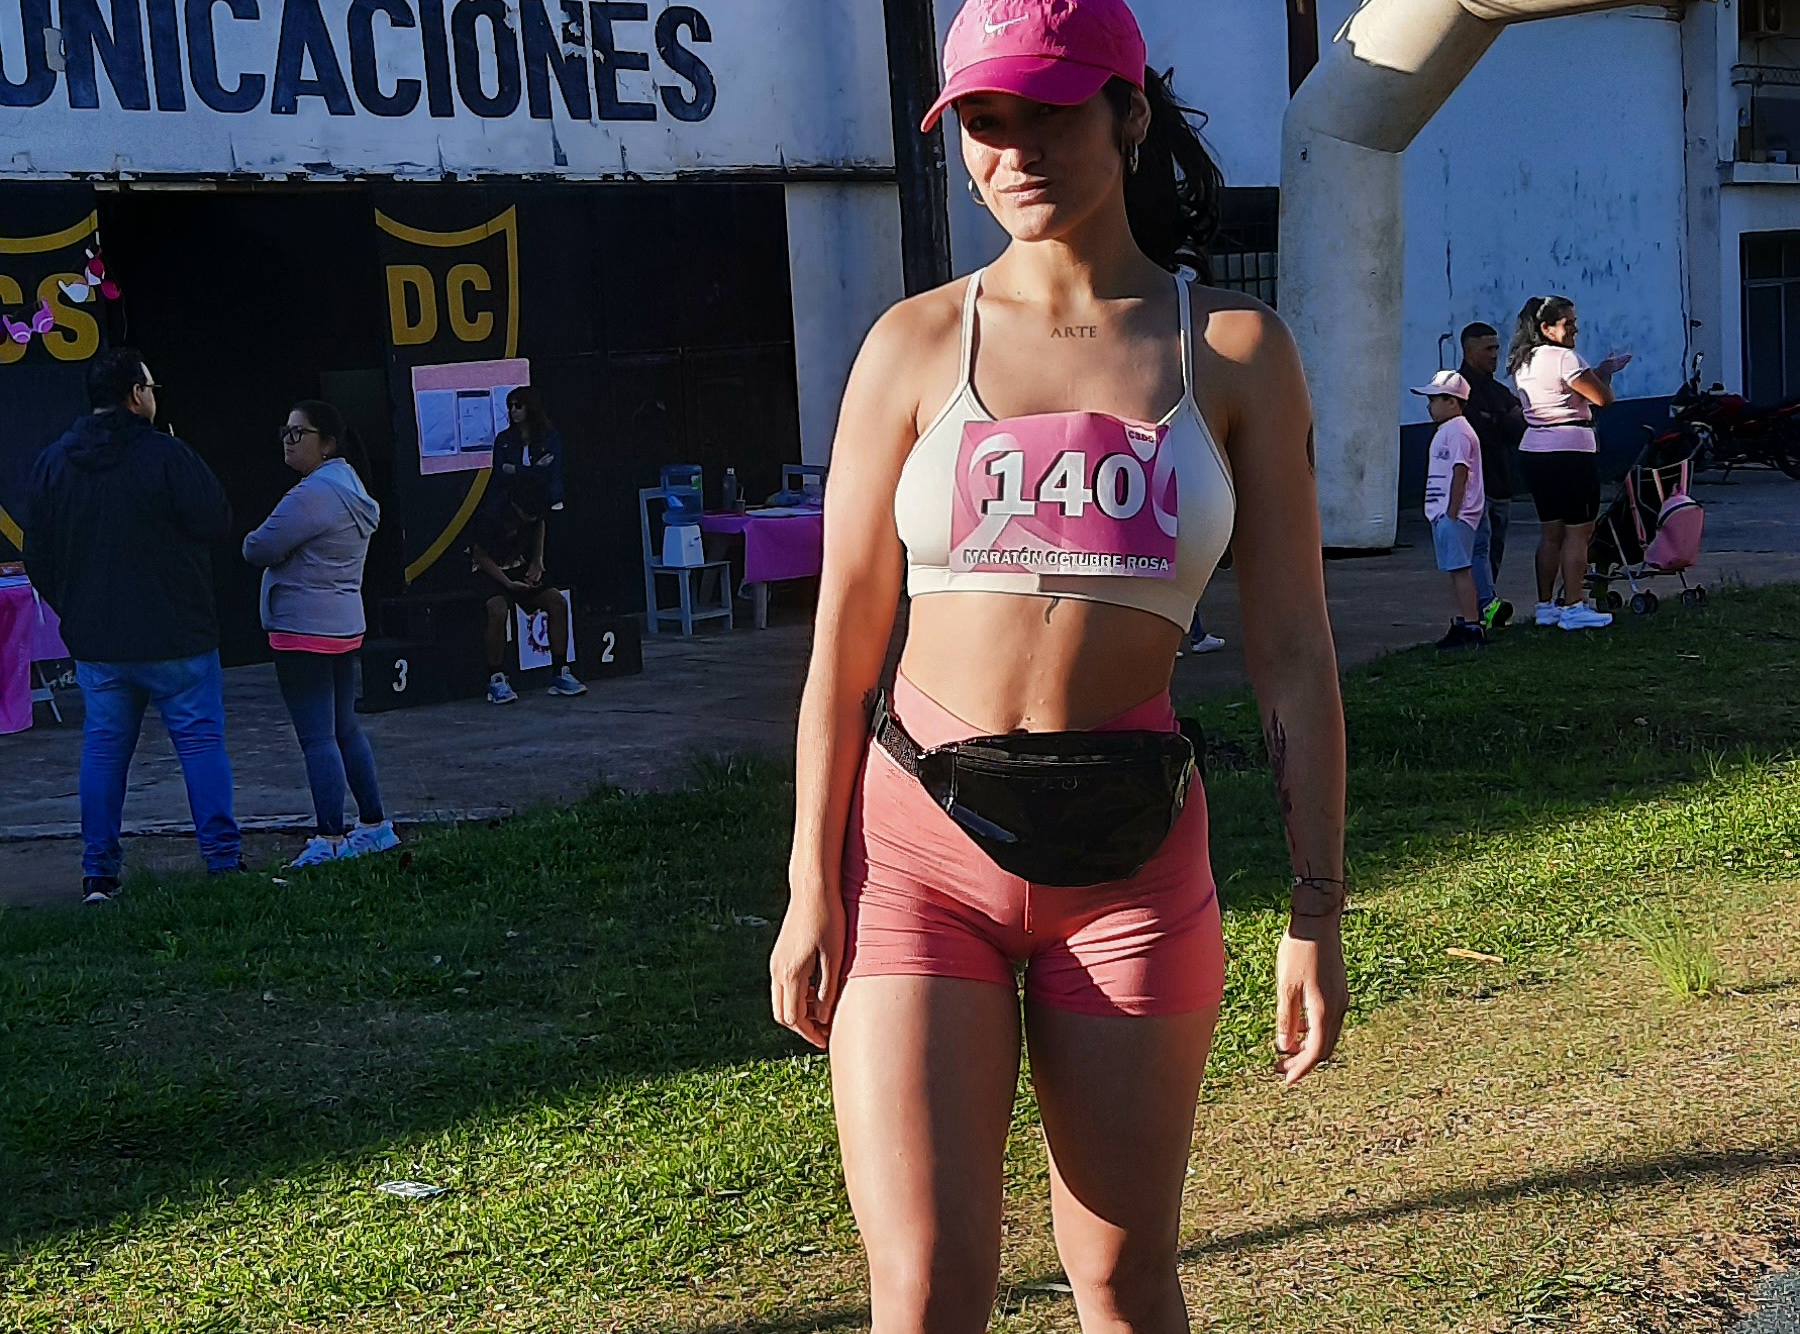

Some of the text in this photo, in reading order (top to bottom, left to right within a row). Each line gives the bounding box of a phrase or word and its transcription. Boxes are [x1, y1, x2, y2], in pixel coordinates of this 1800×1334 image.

[386, 263, 494, 346] DC
[1050, 325, 1097, 338] ARTE
[984, 451, 1147, 520] 140
[964, 547, 1170, 572] MARATÓN OCTUBRE ROSA
[602, 631, 616, 663] 2
[393, 659, 409, 692] 3
